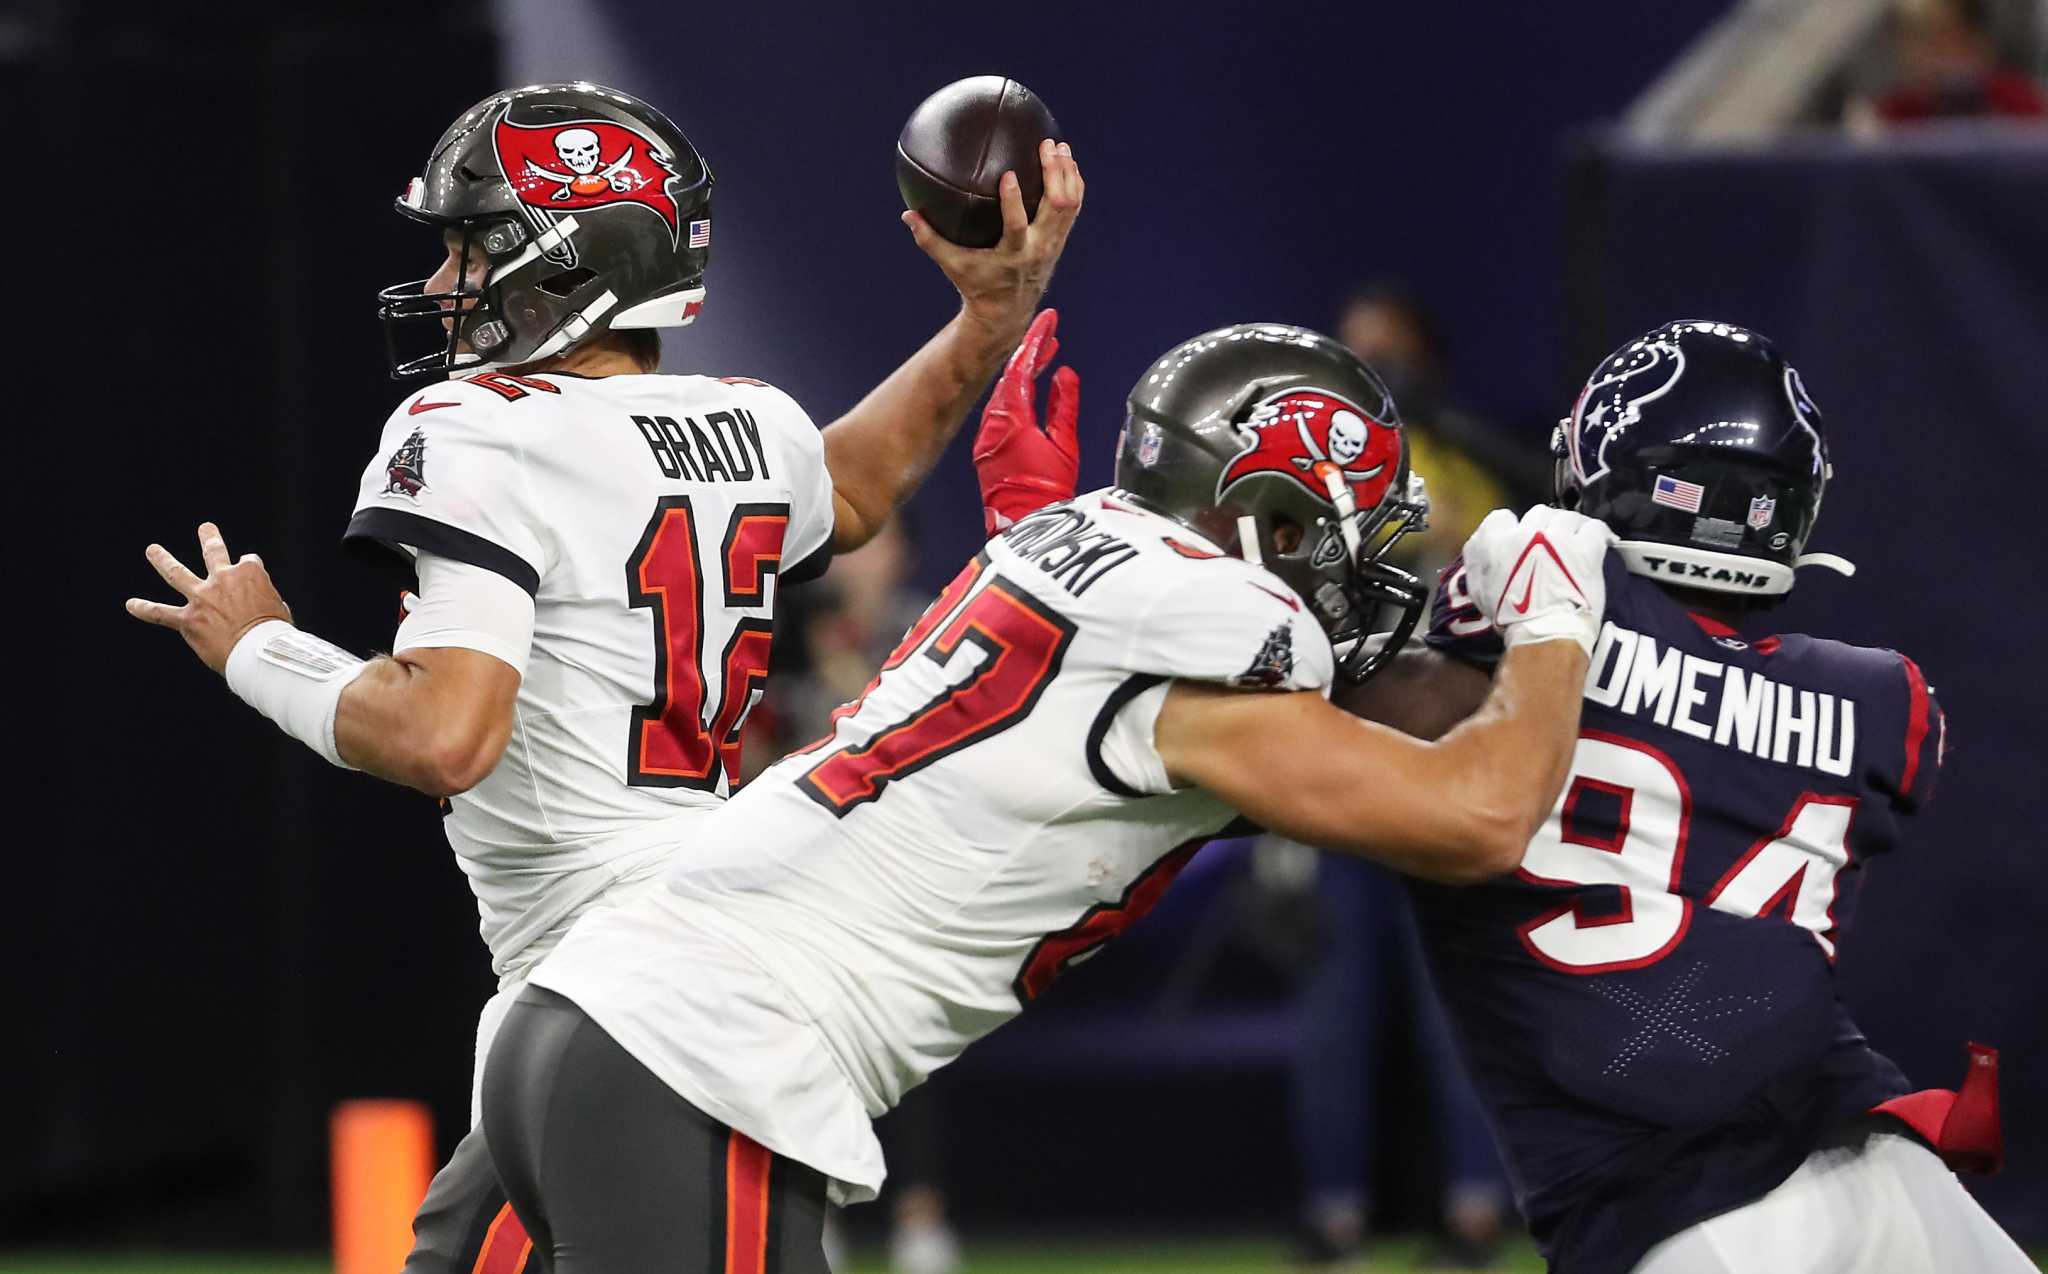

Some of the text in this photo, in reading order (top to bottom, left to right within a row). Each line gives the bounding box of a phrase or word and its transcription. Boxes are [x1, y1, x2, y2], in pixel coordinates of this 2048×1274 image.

[630, 408, 770, 483] BRADY
[626, 495, 790, 800] 12
[1642, 556, 1771, 588] TEXANS
[1584, 621, 1856, 777] OMENIHU
[1516, 728, 1860, 974] 94
